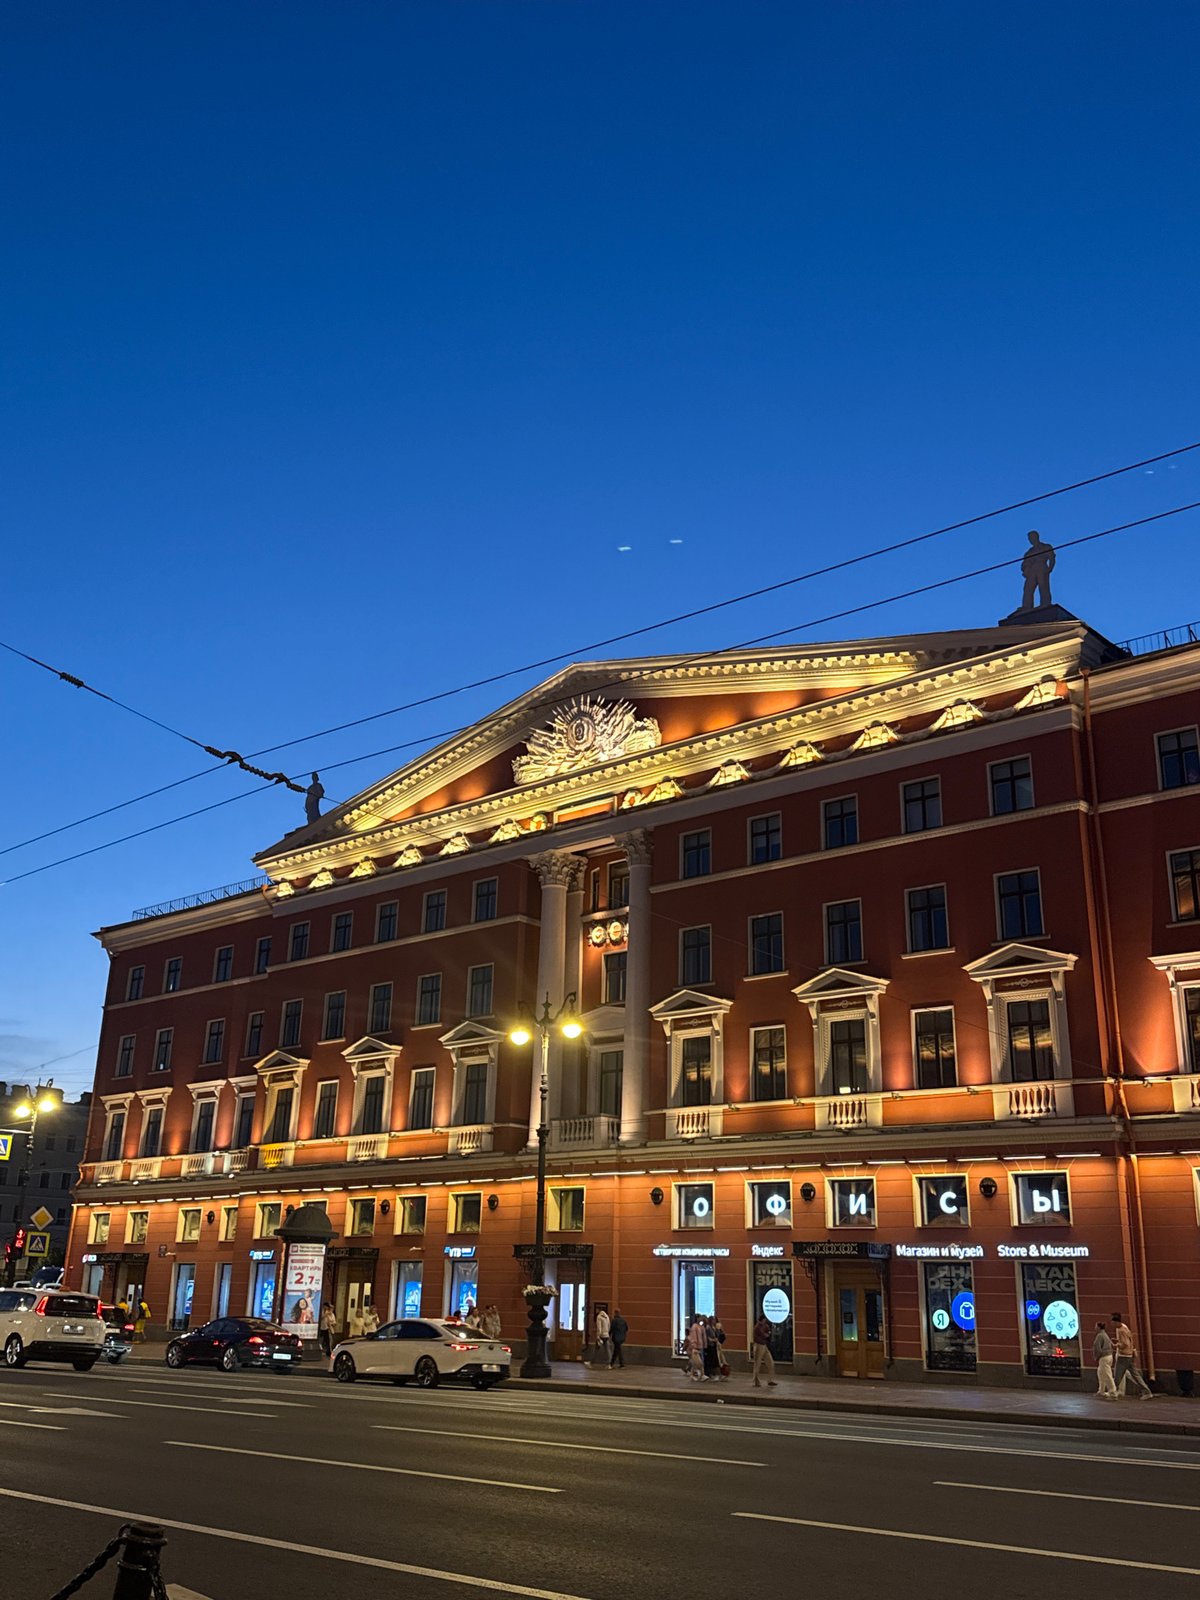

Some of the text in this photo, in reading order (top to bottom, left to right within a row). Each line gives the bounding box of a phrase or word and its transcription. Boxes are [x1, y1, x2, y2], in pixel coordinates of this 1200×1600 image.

[751, 1244, 784, 1257] Яндекс
[896, 1244, 984, 1260] Магазин и музей
[997, 1244, 1089, 1257] Store & Museum
[756, 1275, 790, 1286] ЗИН
